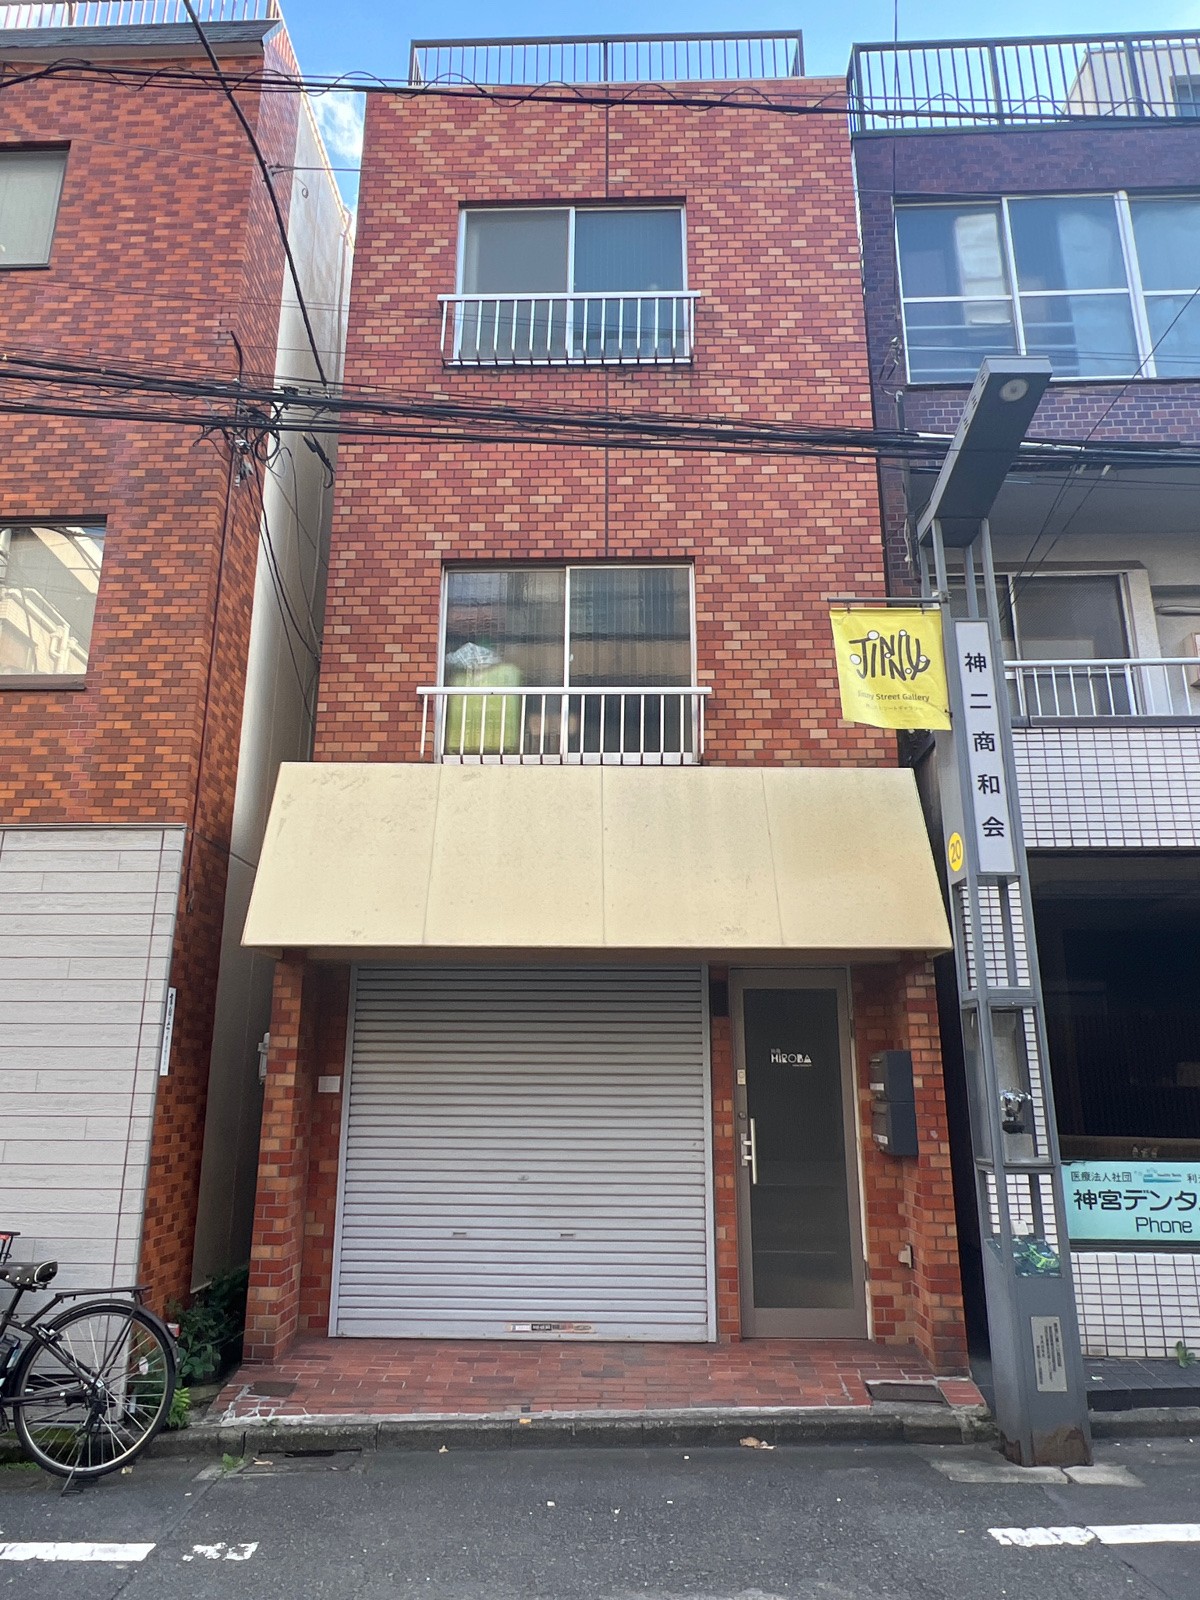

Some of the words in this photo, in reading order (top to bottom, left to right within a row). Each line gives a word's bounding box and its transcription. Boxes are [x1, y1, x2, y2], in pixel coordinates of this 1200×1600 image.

[876, 693, 900, 701] Street
[902, 693, 930, 702] Gallery
[964, 652, 1005, 838] 神二商和会
[950, 839, 962, 864] 20
[1070, 1171, 1132, 1183] 医療法人社団
[1186, 1173, 1200, 1184] 利
[1073, 1189, 1200, 1212] 神宮デンタ
[1135, 1216, 1193, 1233] Phone
